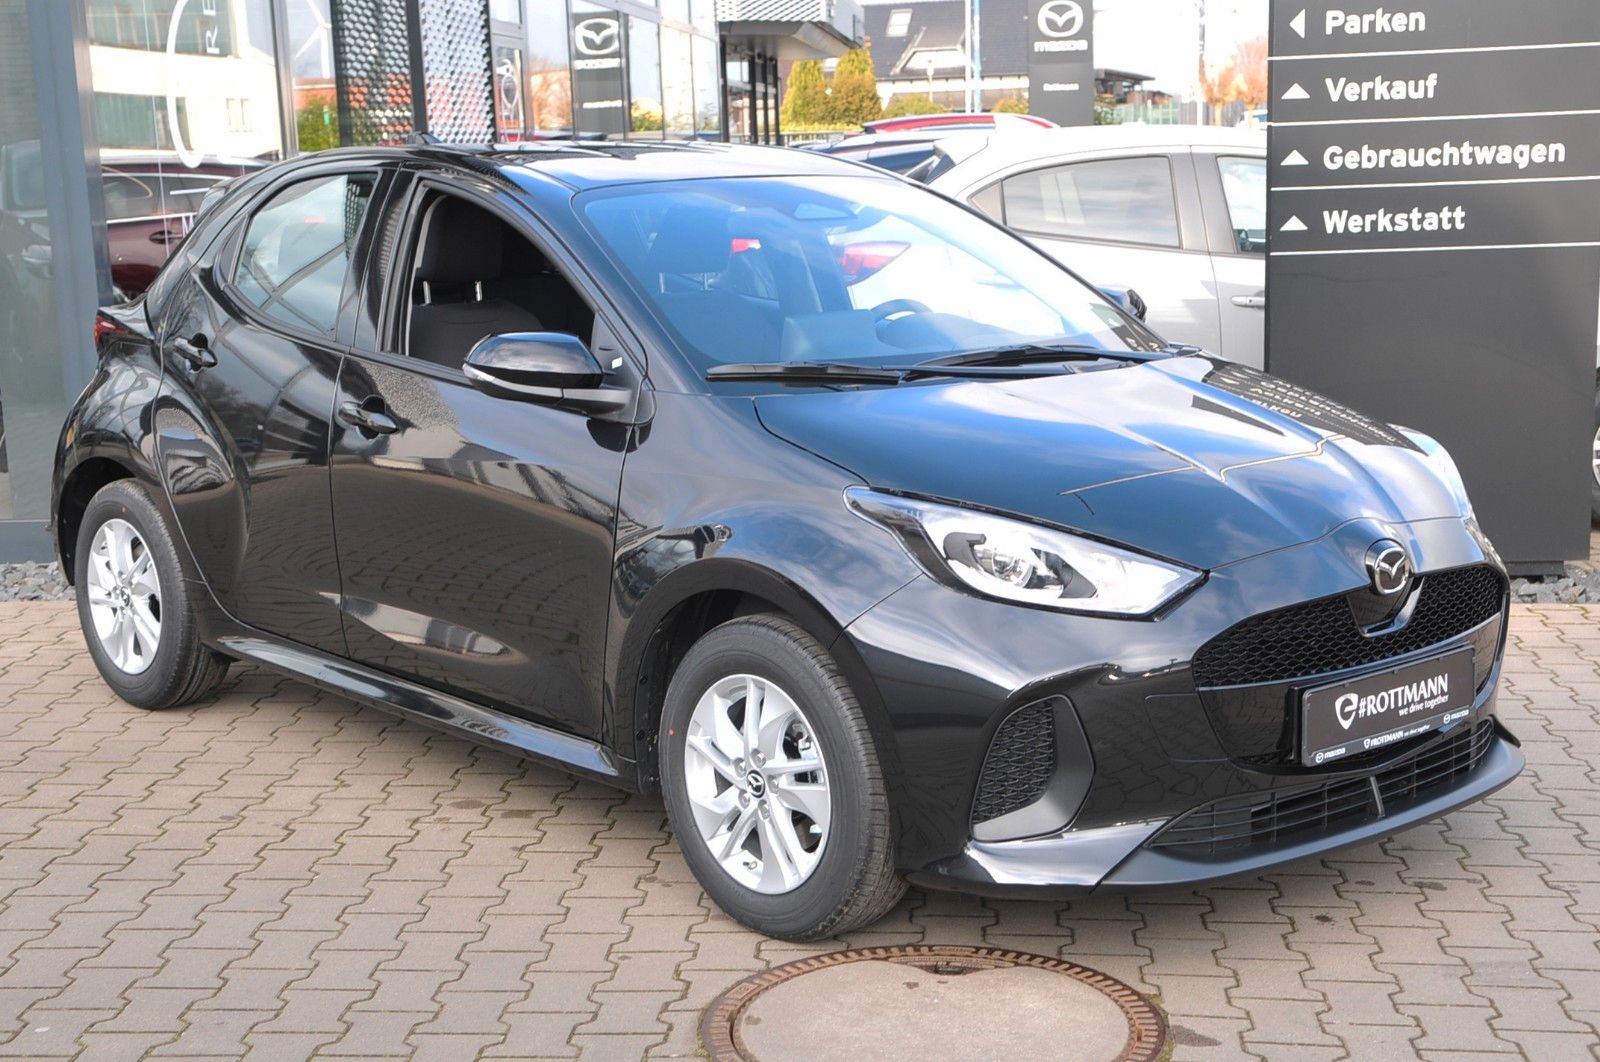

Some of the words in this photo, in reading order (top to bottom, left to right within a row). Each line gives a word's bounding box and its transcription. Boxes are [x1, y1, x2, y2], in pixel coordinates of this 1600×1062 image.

[1325, 8, 1426, 35] Parken
[1325, 73, 1438, 102] Verkauf
[1323, 141, 1566, 170] Gebrauchtwagen
[1323, 205, 1466, 234] Werkstatt
[1358, 673, 1449, 719] #ROTTMANN
[1398, 706, 1409, 716] we
[1409, 701, 1424, 713] drive
[1424, 694, 1449, 709] together
